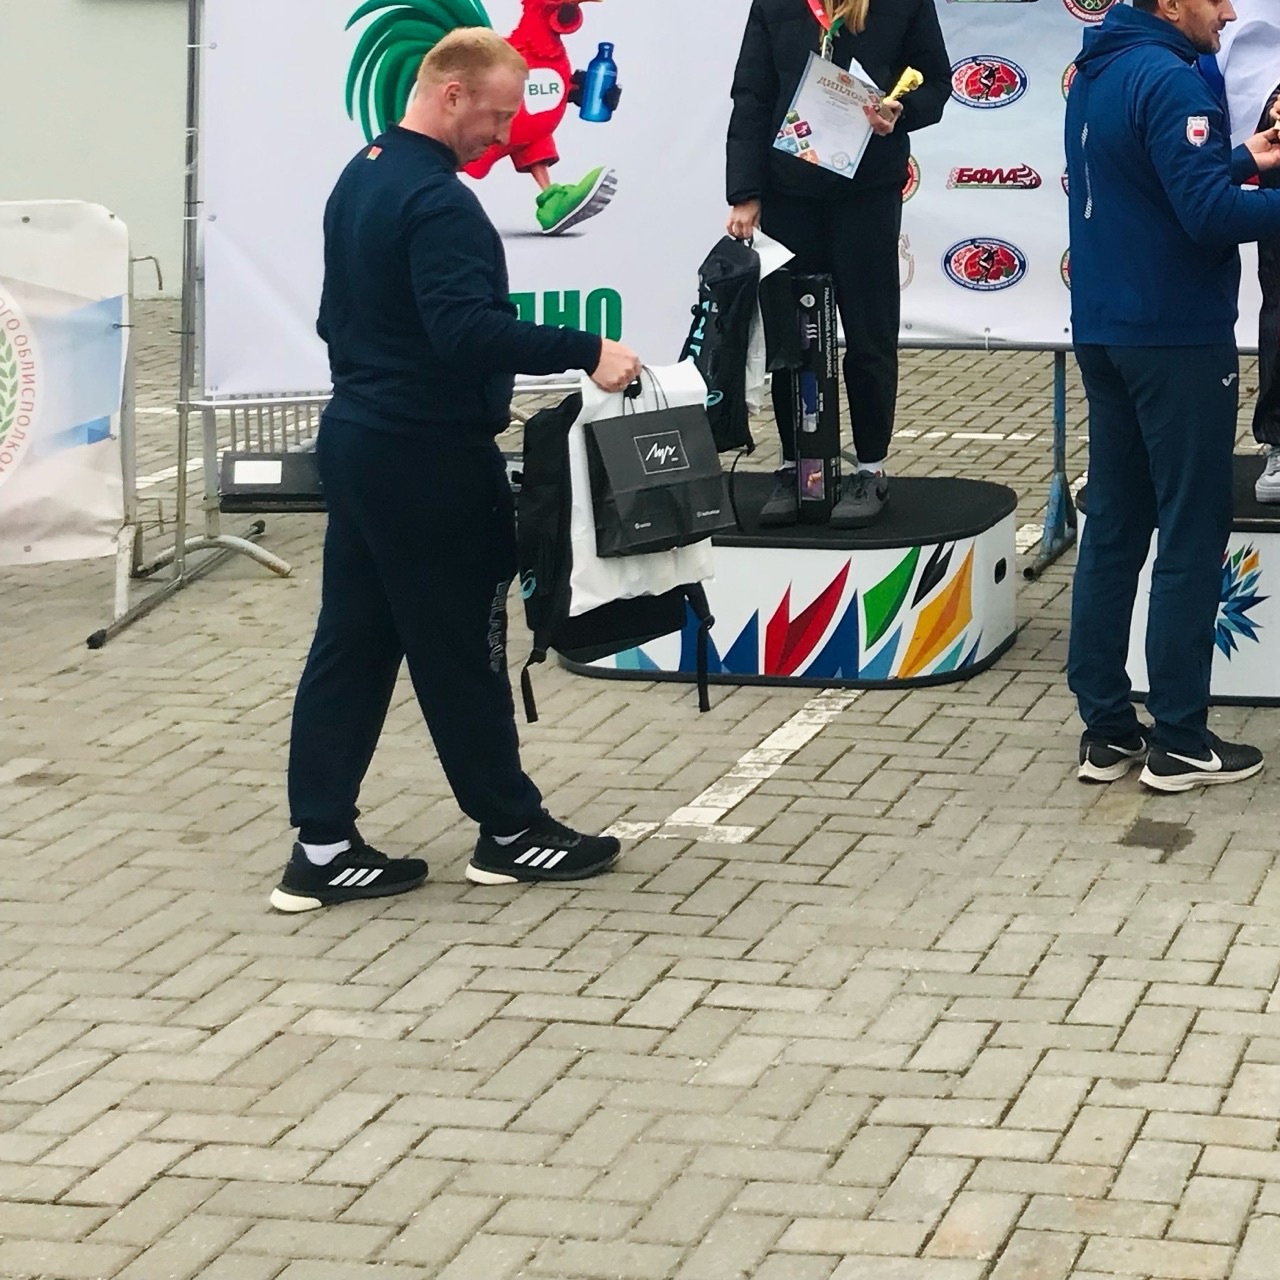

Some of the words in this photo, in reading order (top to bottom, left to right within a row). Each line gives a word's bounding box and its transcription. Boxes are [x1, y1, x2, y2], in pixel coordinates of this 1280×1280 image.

[528, 82, 560, 96] BLR
[956, 167, 1019, 184] БФЛА
[0, 334, 36, 473] ОБЛИСПОЛКО
